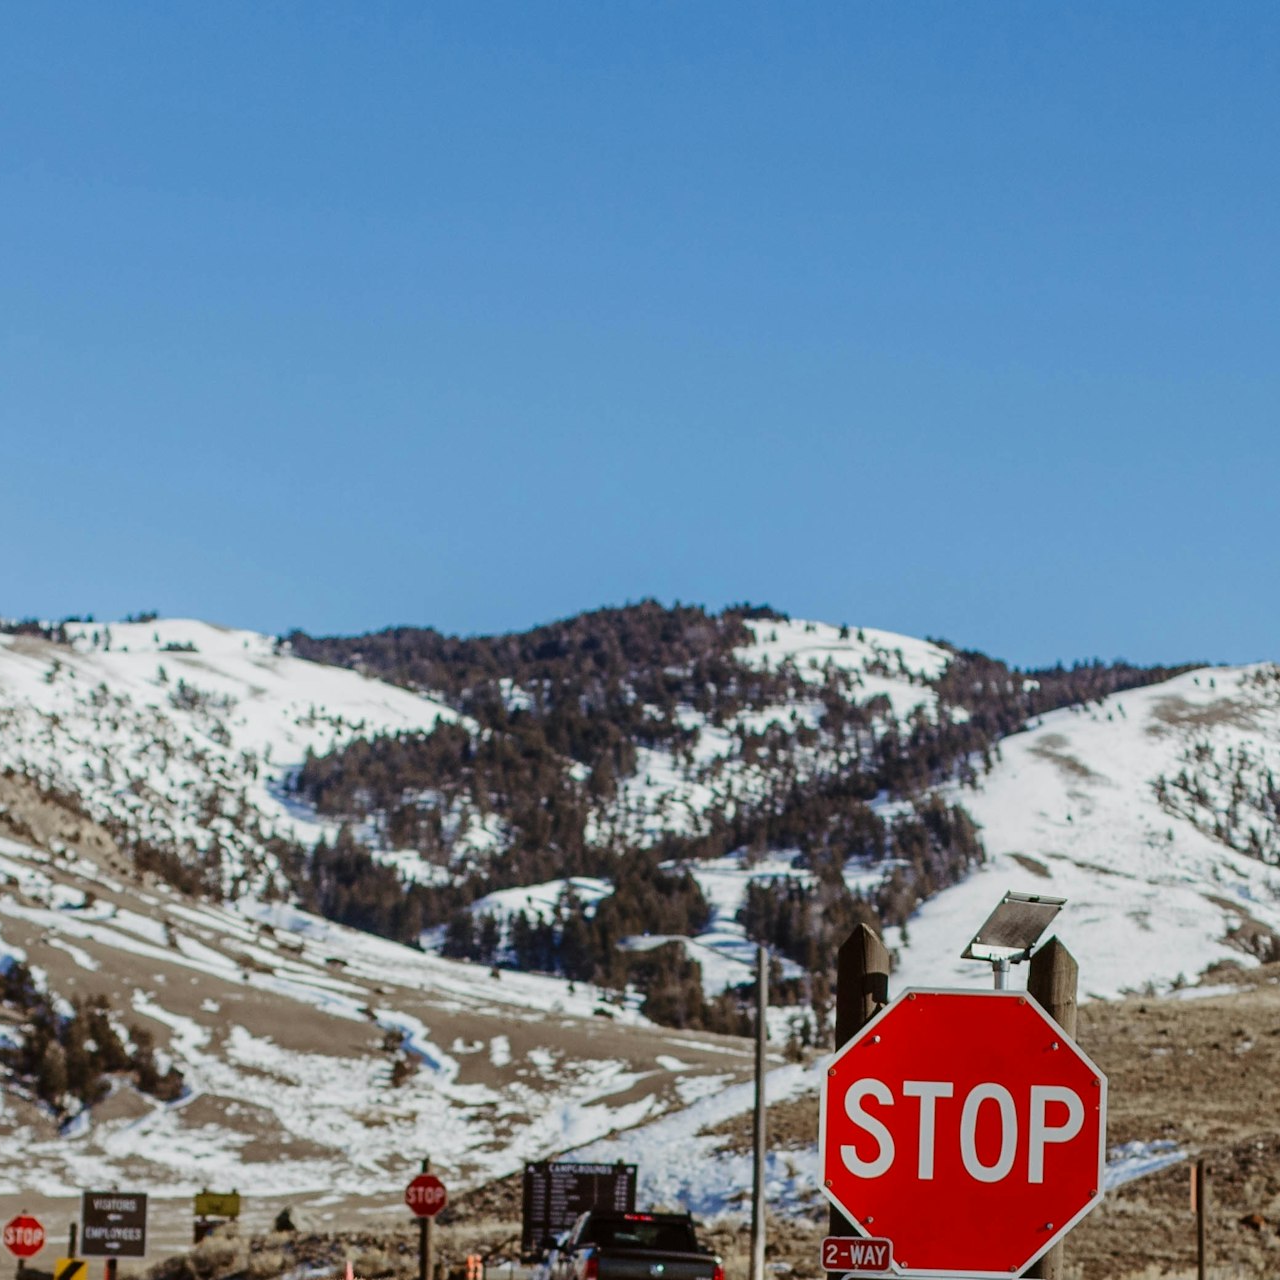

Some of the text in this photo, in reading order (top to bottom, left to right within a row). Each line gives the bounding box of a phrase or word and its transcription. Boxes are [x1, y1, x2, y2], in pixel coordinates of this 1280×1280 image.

[840, 1077, 1085, 1184] STOP
[407, 1186, 445, 1204] STOP
[93, 1199, 136, 1211] VISITORS
[4, 1227, 43, 1246] STOP
[85, 1227, 141, 1240] EMPLOYEES
[825, 1243, 887, 1266] 2-WAY
